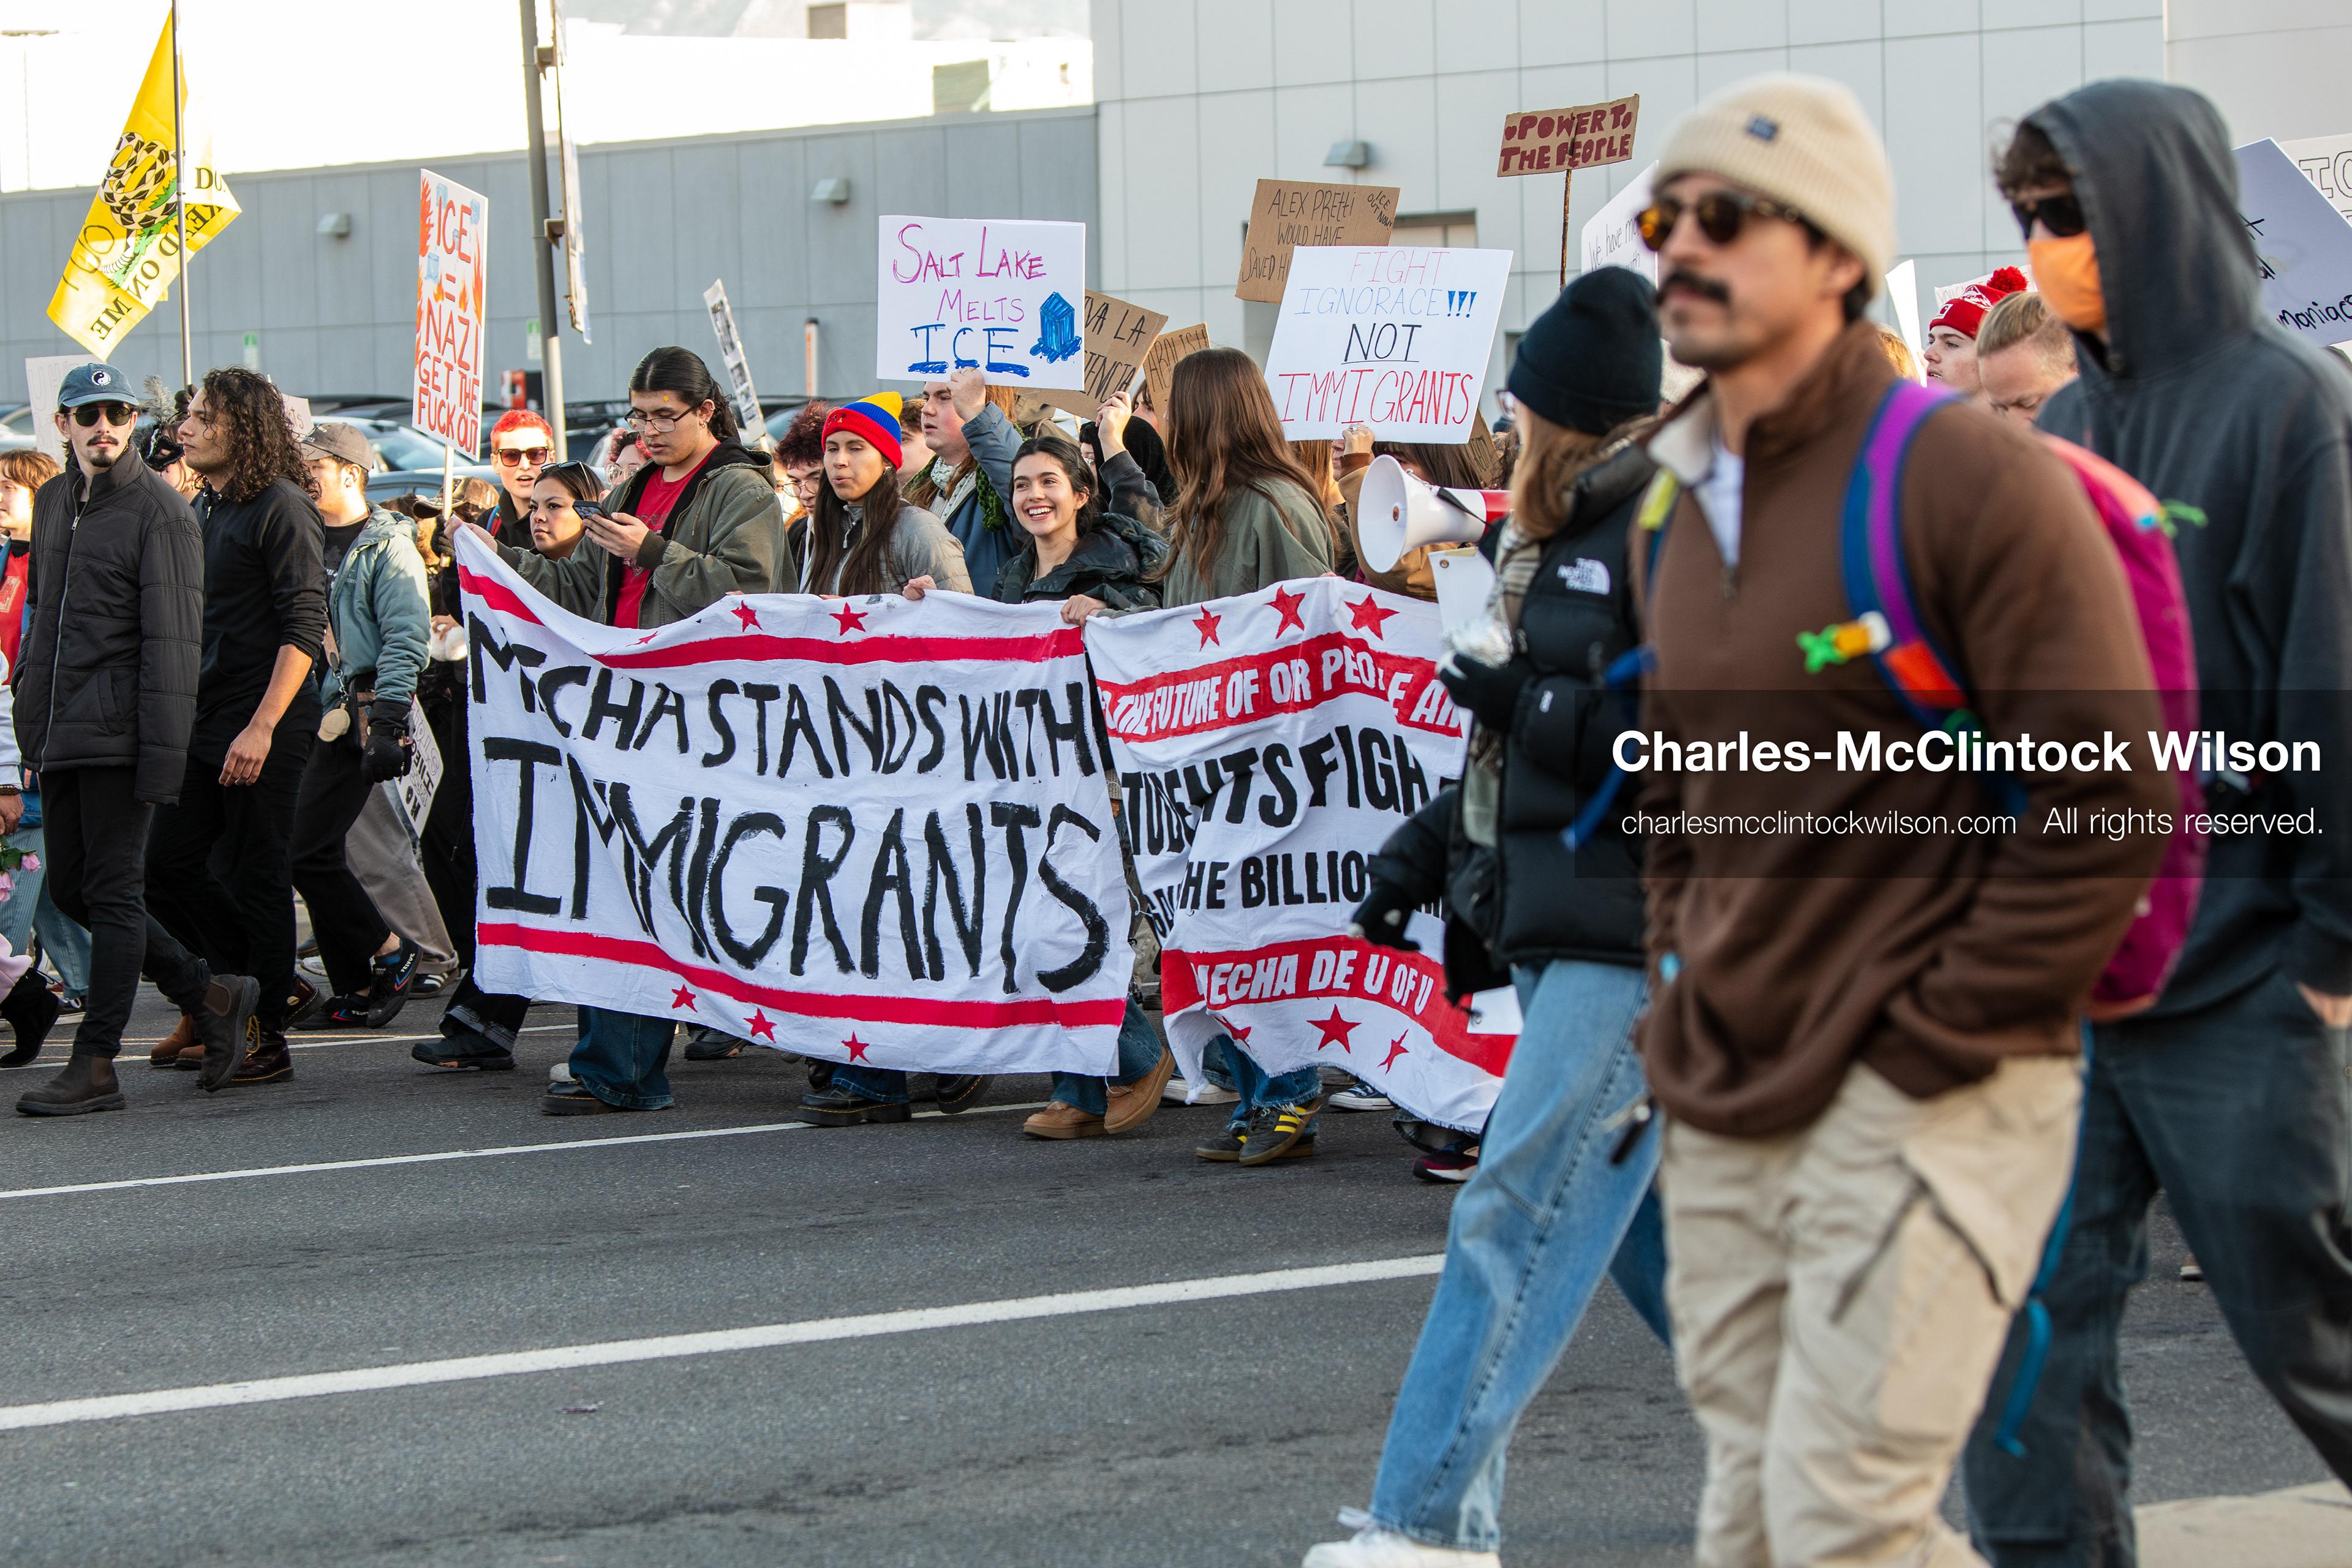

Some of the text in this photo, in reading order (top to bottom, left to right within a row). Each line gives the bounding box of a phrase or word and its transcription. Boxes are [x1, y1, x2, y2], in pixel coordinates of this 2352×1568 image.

[1517, 110, 1607, 140] POWER
[1500, 134, 1631, 172] THE PEOPLE
[437, 195, 472, 264] ICE
[1268, 188, 1309, 219] ALEX
[1367, 194, 1392, 230] OUT NOW!
[893, 223, 1047, 283] SALT LAKE
[1278, 222, 1345, 246] WOULD HAVE
[1606, 224, 1623, 257] have
[1242, 247, 1276, 282] SAVED
[1350, 250, 1450, 285] FIGHT
[937, 288, 1025, 322] MELTS
[1114, 309, 1146, 347] LA
[425, 296, 478, 375] NAZI
[908, 323, 1030, 378] ICE
[1343, 323, 1423, 363] NOT
[418, 350, 480, 419] GET THE
[1278, 369, 1474, 425] IMMIGRANTS
[418, 385, 478, 455] FUCK OUT
[700, 674, 948, 780] STANDS
[958, 680, 1098, 782] WITH
[1113, 692, 1155, 736] THE
[1152, 676, 1222, 734] FUTURE
[1226, 668, 1259, 718] OF
[1298, 725, 1460, 817] FIGH
[482, 736, 1111, 995] IMMIGRANTS
[1242, 850, 1372, 909] BILLIO
[1308, 949, 1359, 992] DE
[1363, 954, 1390, 995] U
[1392, 963, 1419, 1007] OF
[1414, 974, 1435, 1016] U
